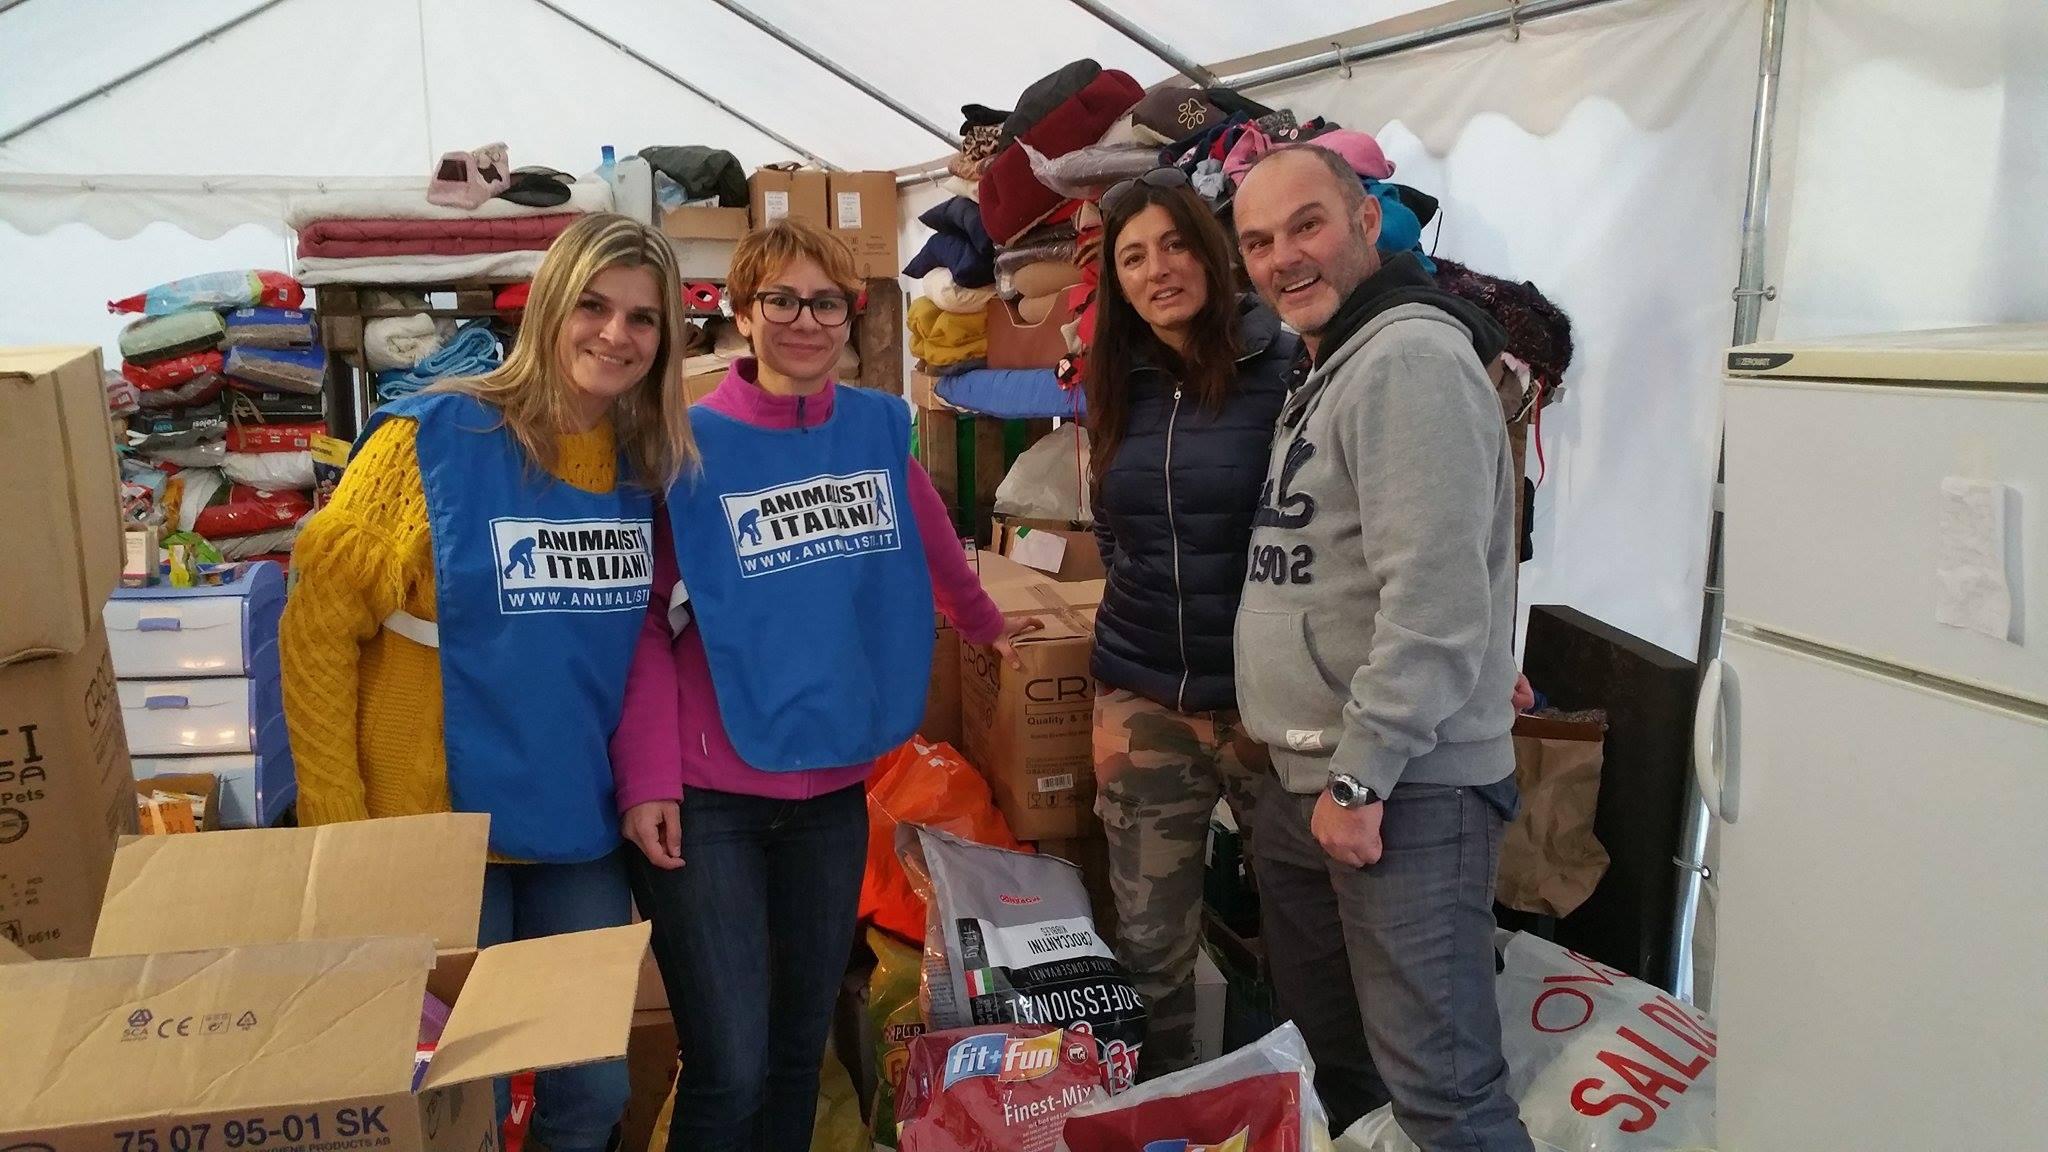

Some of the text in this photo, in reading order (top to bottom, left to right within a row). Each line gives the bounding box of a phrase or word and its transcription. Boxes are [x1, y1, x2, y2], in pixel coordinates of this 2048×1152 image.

[770, 504, 873, 541] ITALANI
[538, 529, 645, 551] ANIMAISTI
[743, 533, 893, 572] WWW.ANIMLISTI.IT
[546, 554, 647, 581] ITALIANI
[1250, 544, 1314, 585] 1902
[1027, 713, 1064, 726] Quality
[1, 789, 45, 805] Pets
[1027, 931, 1093, 955] CROCCANTINI
[1003, 1084, 1091, 1127] Finest-Mix
[114, 1105, 388, 1152] 75 07 95-01 SK
[308, 1139, 373, 1152] PRODUCTS
